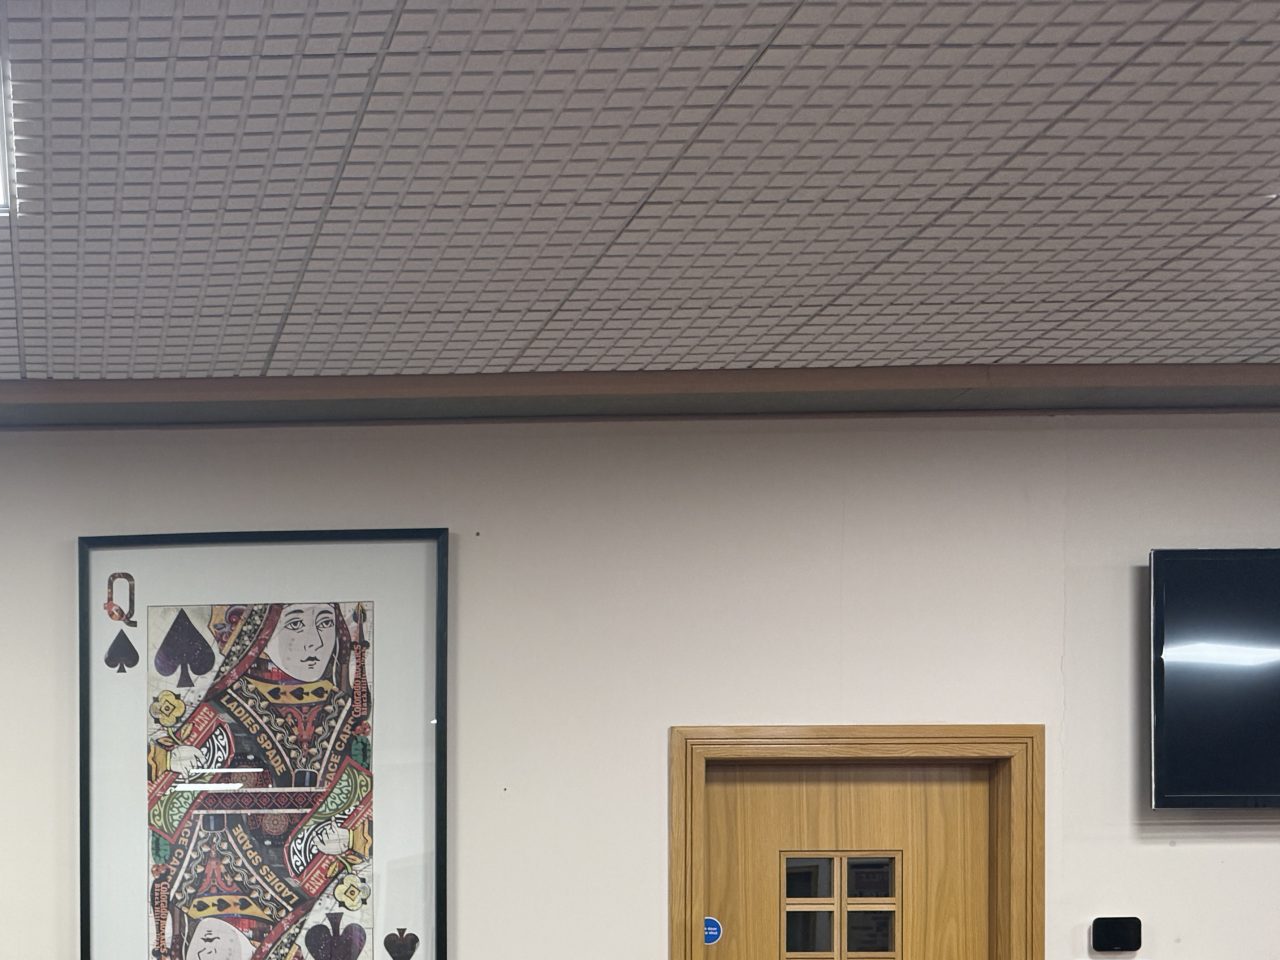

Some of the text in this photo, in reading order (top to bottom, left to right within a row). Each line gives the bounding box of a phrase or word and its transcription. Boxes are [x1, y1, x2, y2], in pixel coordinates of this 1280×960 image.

[104, 572, 137, 628] Q
[221, 694, 287, 776] LADIES SPADE
[178, 820, 193, 846] ACE
[232, 823, 299, 905] LADIES SPADE
